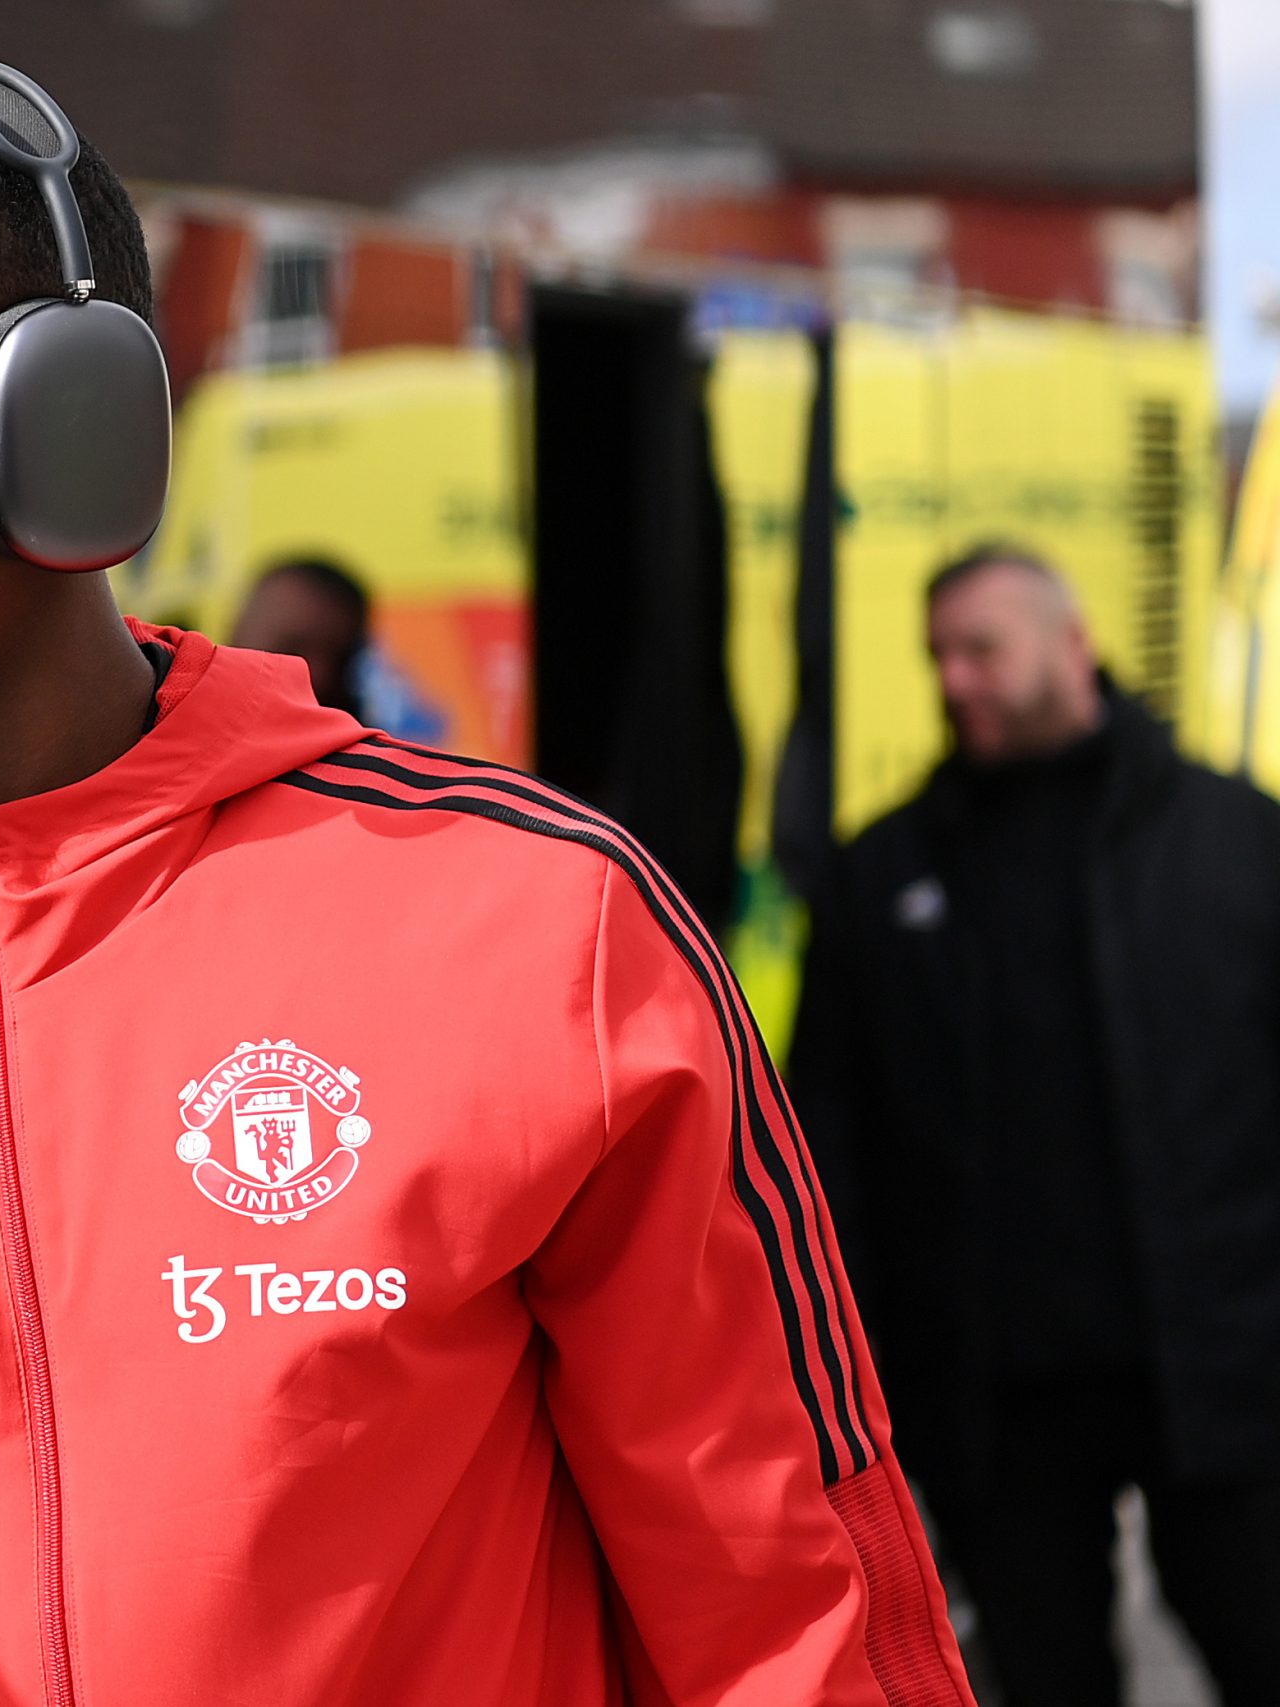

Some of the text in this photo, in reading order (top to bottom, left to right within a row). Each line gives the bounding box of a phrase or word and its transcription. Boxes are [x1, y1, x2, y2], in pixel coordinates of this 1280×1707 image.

[192, 1052, 347, 1117] MANCHESTER
[225, 1175, 333, 1212] UNITED
[234, 1262, 407, 1317] Tezos
